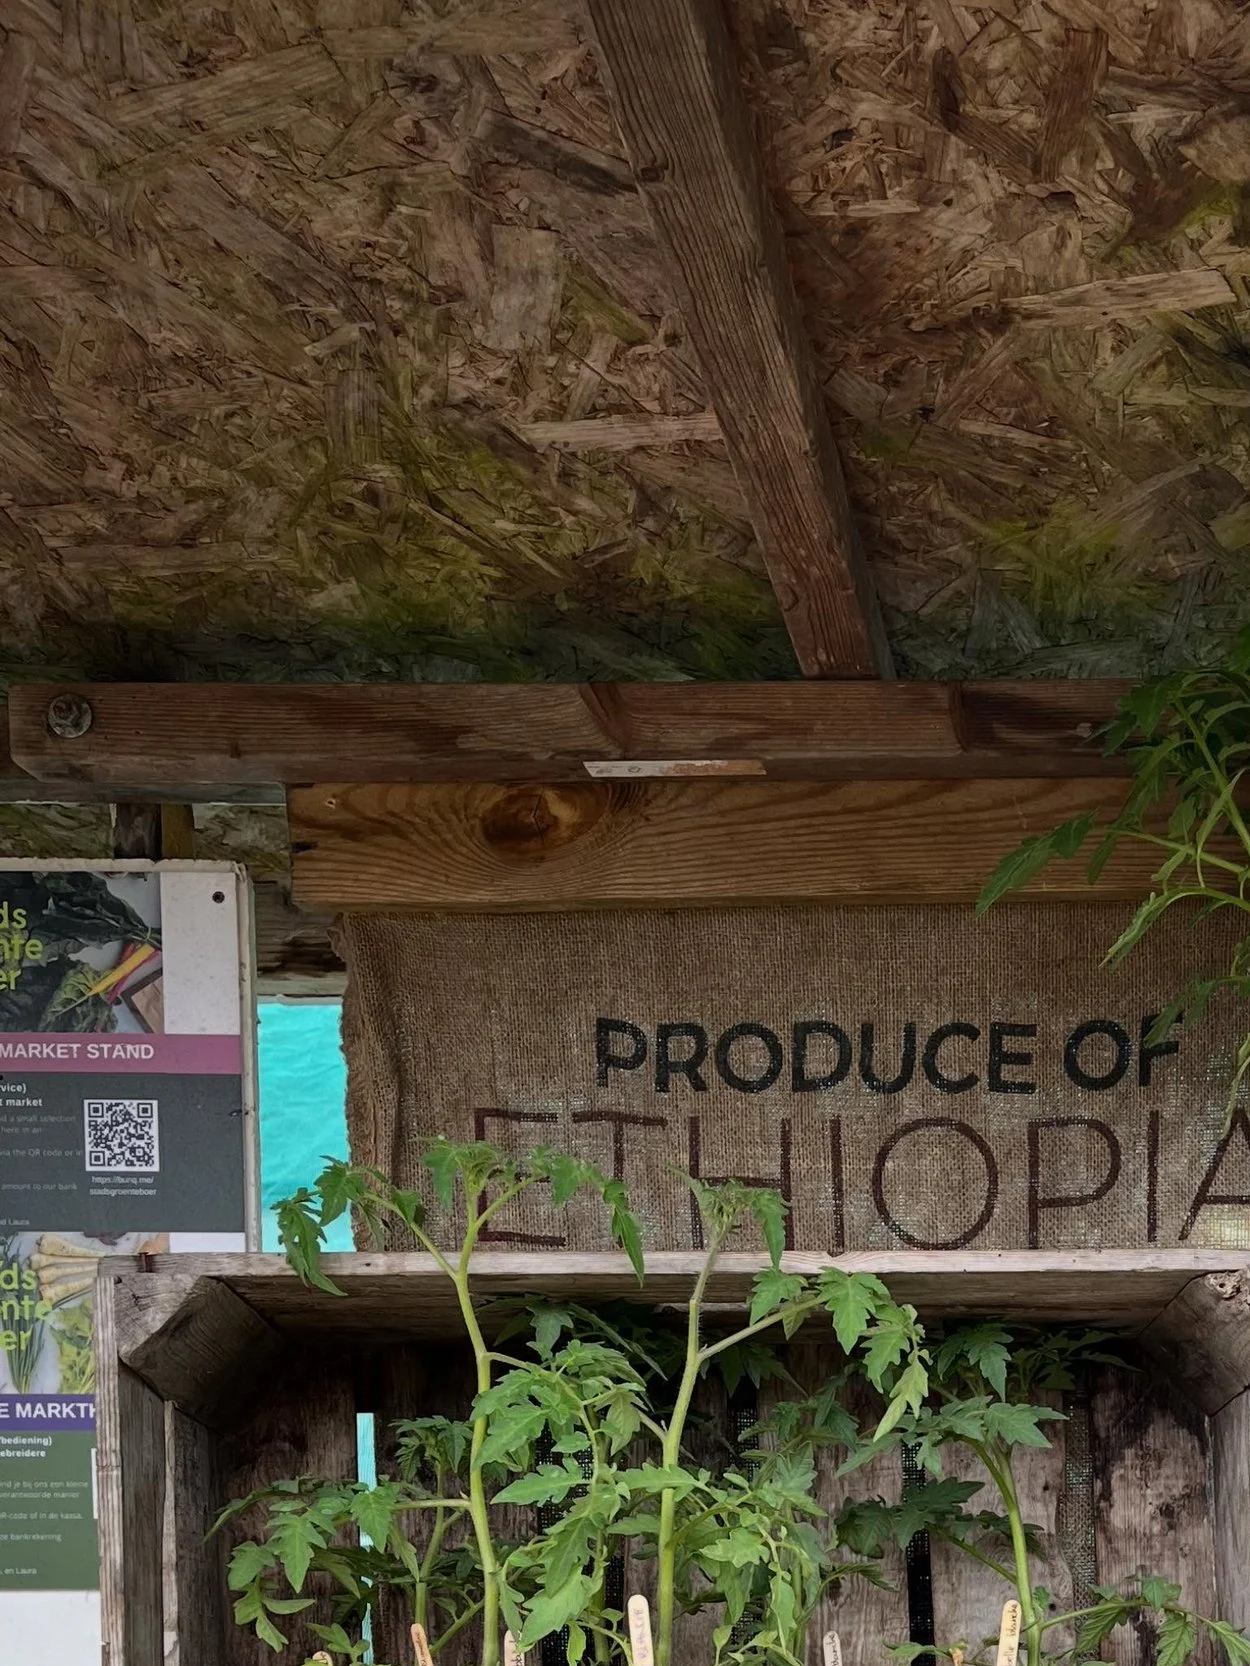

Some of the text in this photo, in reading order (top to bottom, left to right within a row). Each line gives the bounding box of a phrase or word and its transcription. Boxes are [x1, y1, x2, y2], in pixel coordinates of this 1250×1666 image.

[87, 1043, 155, 1060] STAND
[595, 1013, 1183, 1095] PRODUCE OF
[0, 1436, 52, 1446] bediening)
